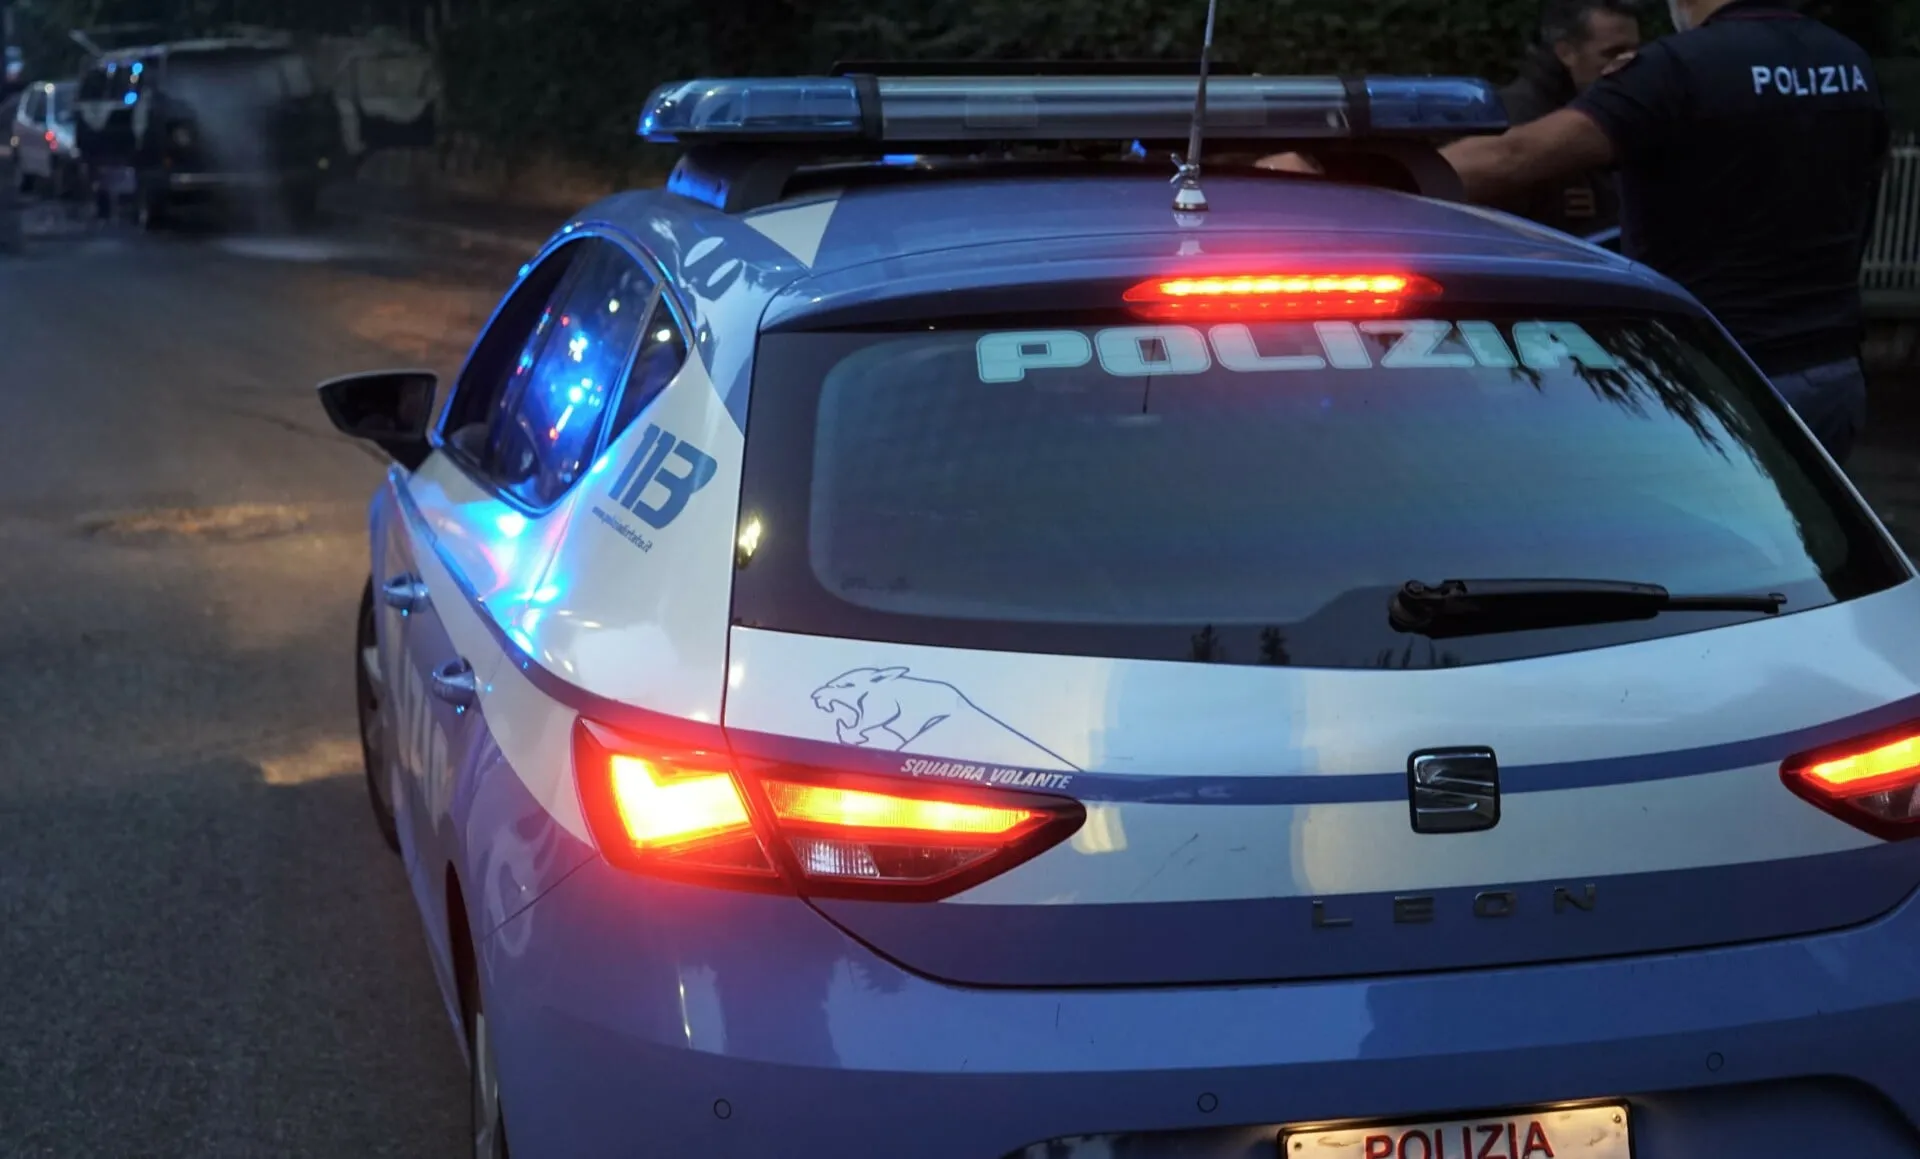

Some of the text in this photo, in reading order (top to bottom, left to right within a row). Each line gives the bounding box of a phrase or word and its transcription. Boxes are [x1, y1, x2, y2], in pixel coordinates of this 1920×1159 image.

[1751, 64, 1868, 96] POLIZIA
[976, 319, 1618, 383] POLIZIA
[608, 423, 718, 530] 113
[901, 758, 1073, 790] SQUADRA VOLANTE
[1312, 884, 1595, 928] LEON
[1365, 1121, 1555, 1159] POLIZIA
